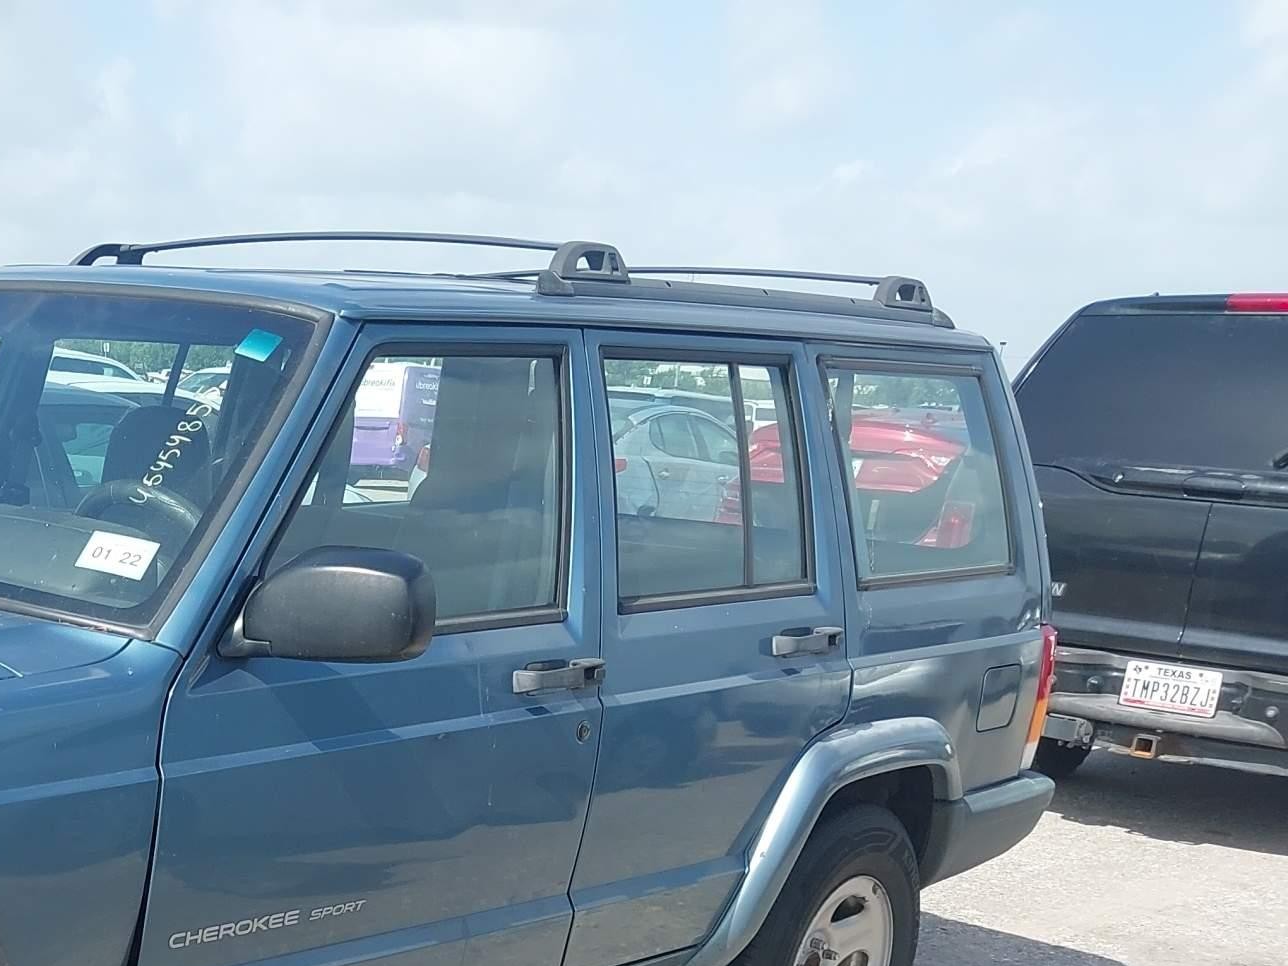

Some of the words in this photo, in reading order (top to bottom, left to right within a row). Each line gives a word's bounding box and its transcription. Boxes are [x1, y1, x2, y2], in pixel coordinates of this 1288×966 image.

[128, 385, 221, 504] 45454855
[92, 546, 112, 561] 01
[119, 551, 142, 567] 22
[1156, 667, 1193, 680] TEXAS
[1131, 678, 1211, 708] TMP32BZJ
[168, 909, 301, 950] CHEROKEE
[309, 899, 367, 922] SPORT
